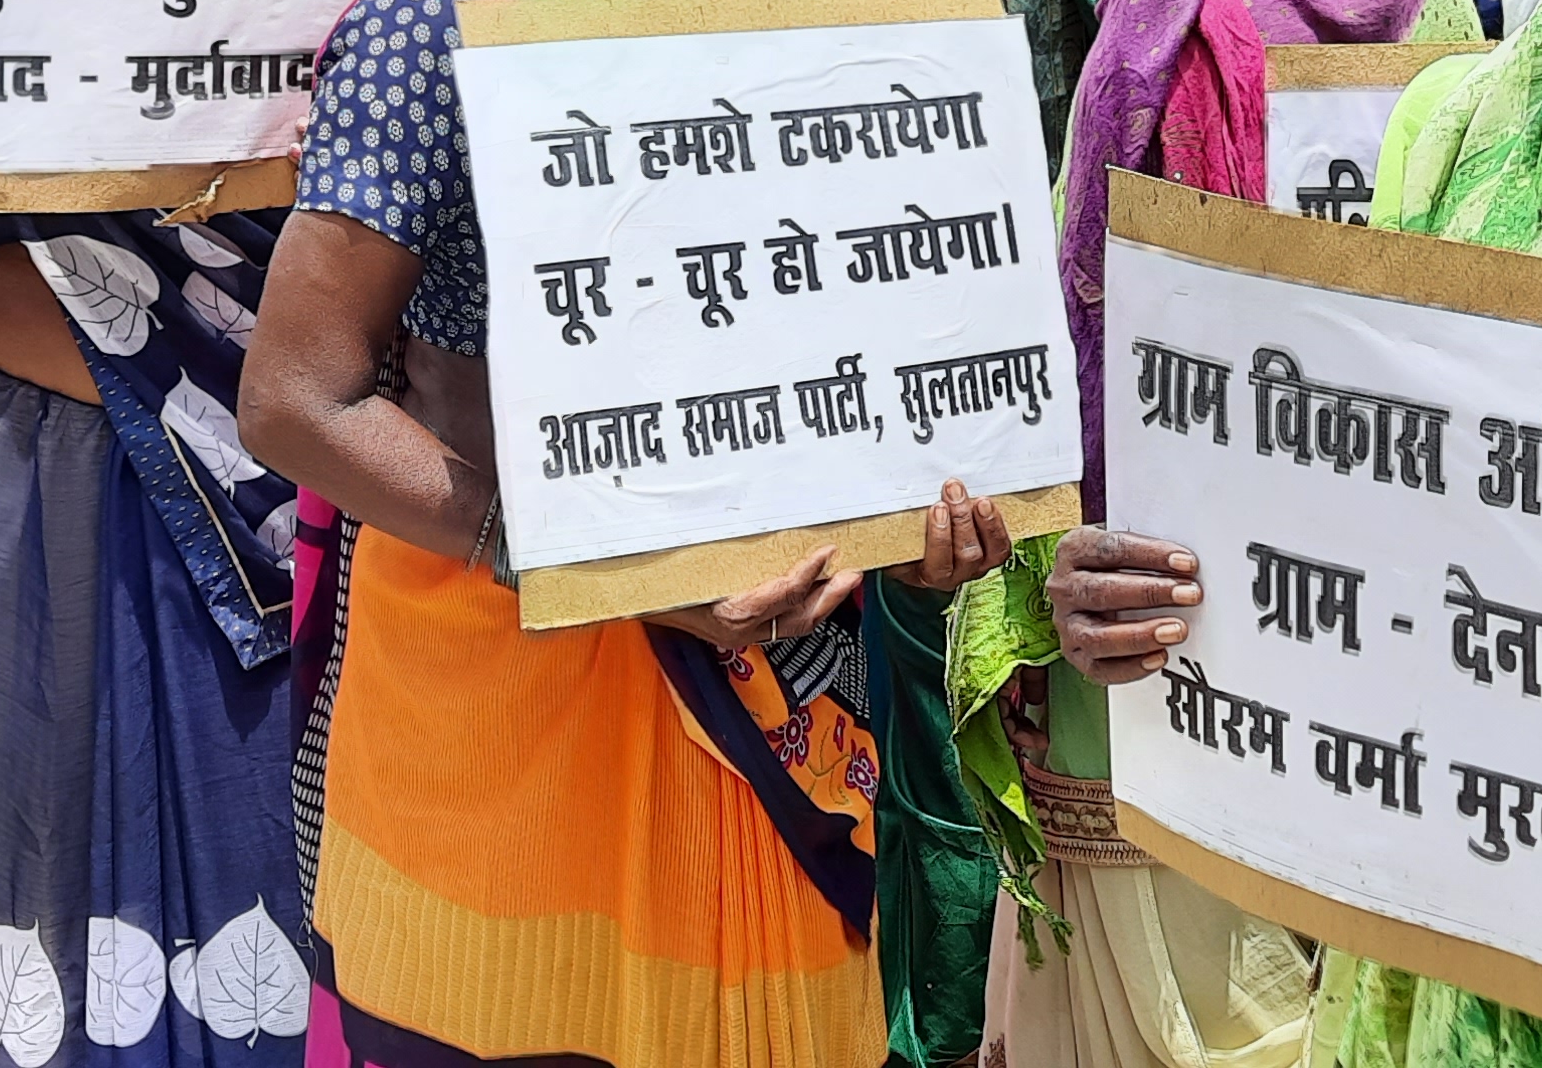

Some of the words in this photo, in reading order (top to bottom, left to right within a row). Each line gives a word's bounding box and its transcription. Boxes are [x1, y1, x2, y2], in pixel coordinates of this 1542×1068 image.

[531, 110, 614, 187] जो
[770, 84, 987, 166] टकरायेगा
[534, 257, 612, 346] चूर
[636, 277, 653, 287] -
[676, 242, 748, 328] चूर
[764, 218, 822, 295] हो
[836, 203, 1019, 283] जायेगा।
[539, 402, 666, 487] आज़ाद
[676, 385, 785, 457] समाज
[793, 353, 883, 442] पार्टी,
[894, 344, 1051, 444] सुलतानपुर
[1132, 338, 1232, 446] ग्राम
[1248, 348, 1450, 495] विकास
[1247, 542, 1365, 653] ग्राम
[1392, 617, 1413, 634] -
[1161, 656, 1290, 773] सौरभ
[1309, 722, 1426, 815] वर्मा
